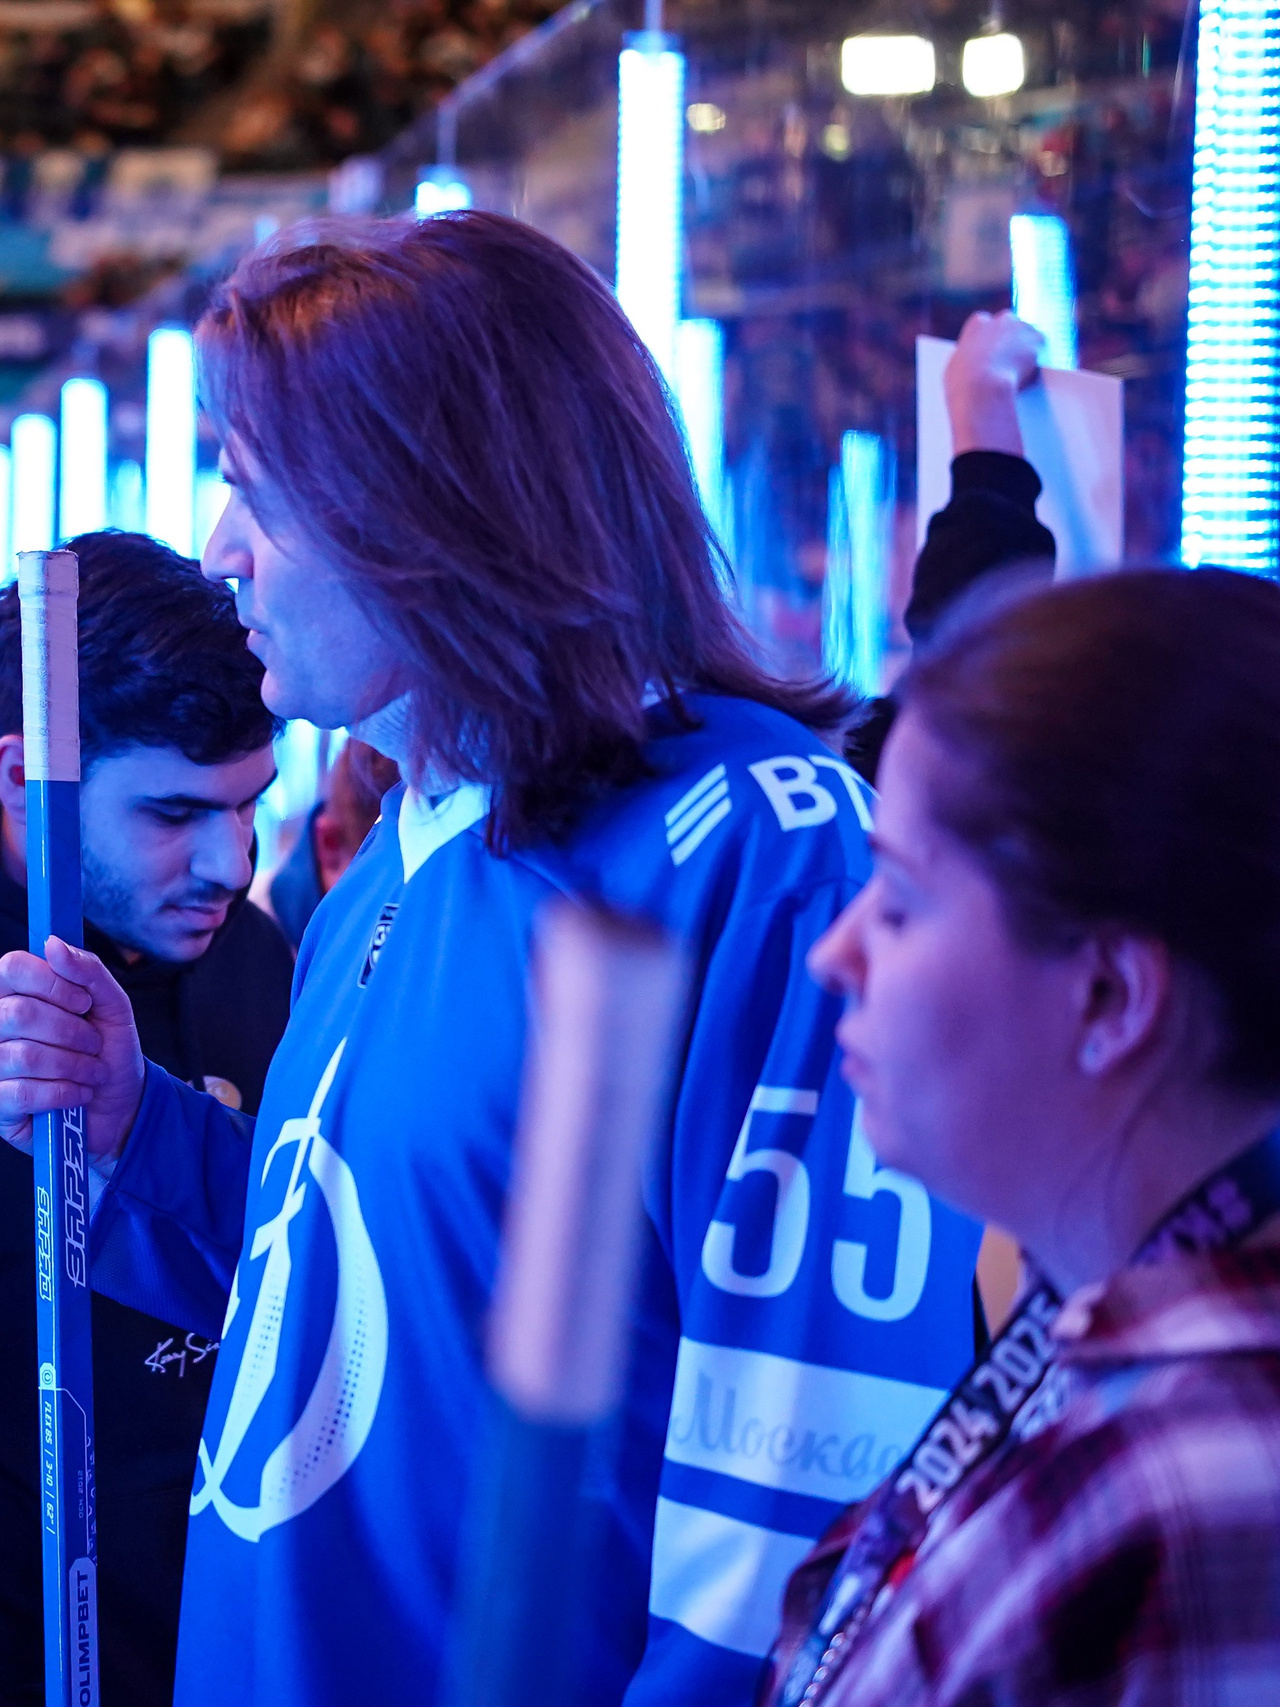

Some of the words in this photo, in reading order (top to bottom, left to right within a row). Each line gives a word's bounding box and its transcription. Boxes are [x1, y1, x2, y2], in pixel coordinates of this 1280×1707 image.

[701, 1085, 932, 1321] 55
[44, 1401, 52, 1429] FLEX
[895, 1399, 1000, 1513] 2024
[45, 1459, 54, 1487] 3-10
[77, 1570, 91, 1707] OLIMPBET
